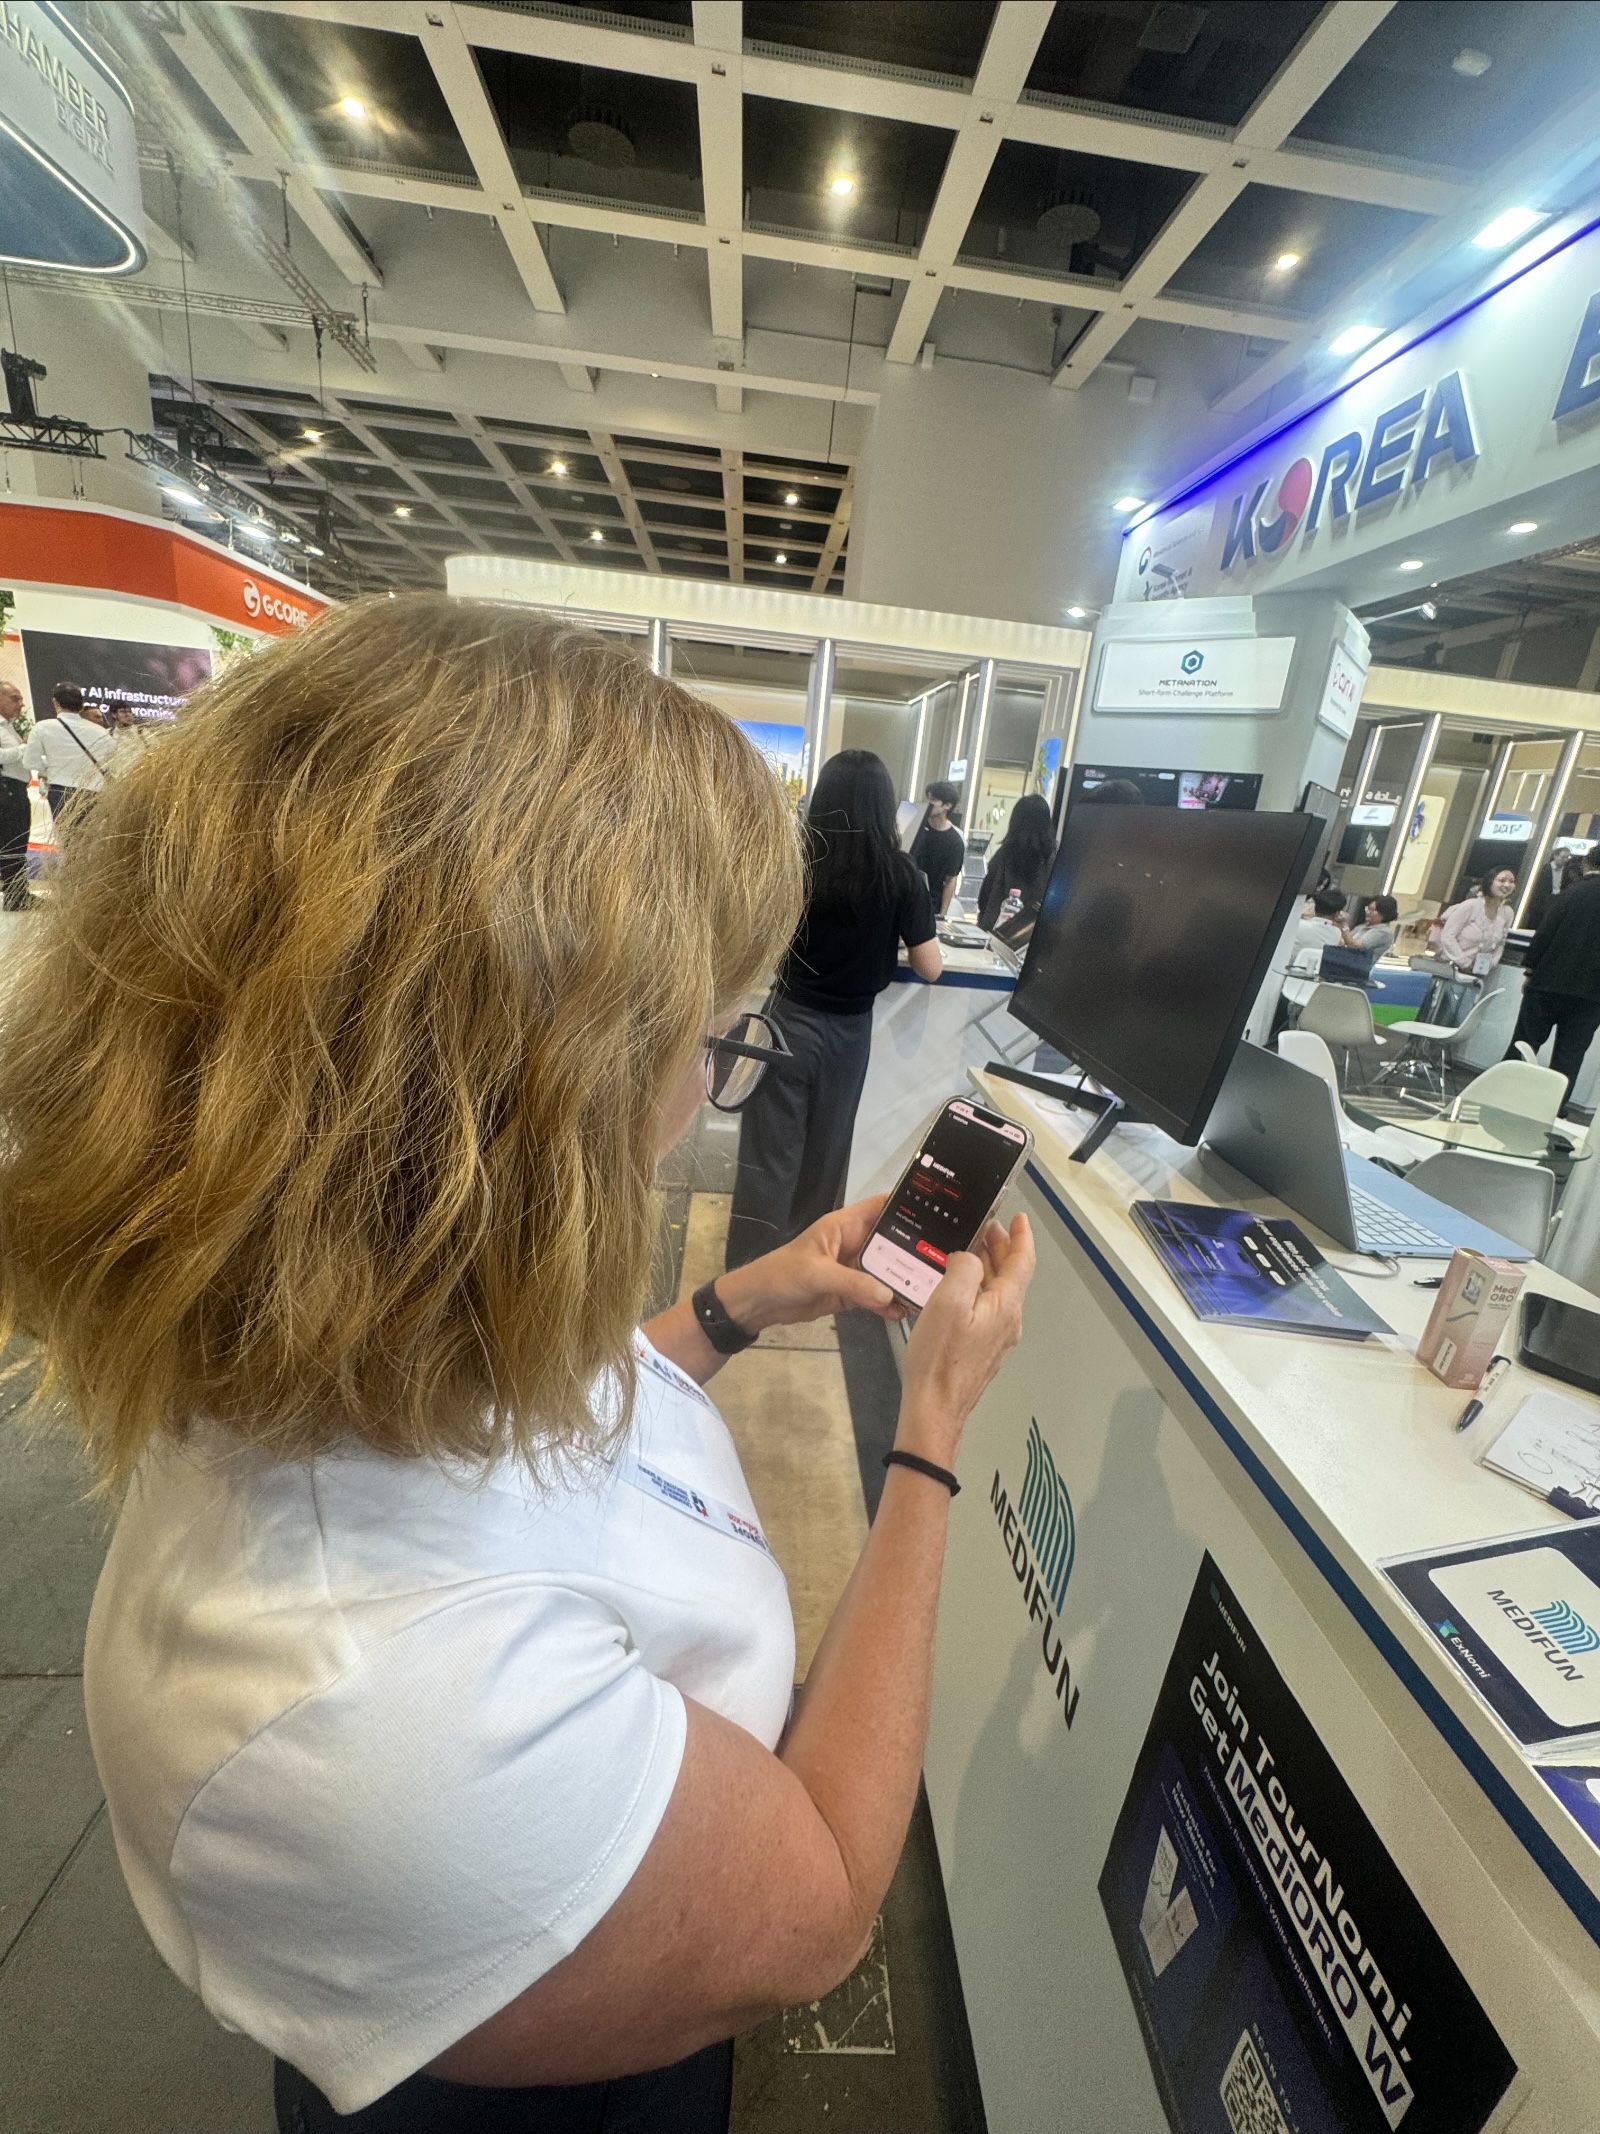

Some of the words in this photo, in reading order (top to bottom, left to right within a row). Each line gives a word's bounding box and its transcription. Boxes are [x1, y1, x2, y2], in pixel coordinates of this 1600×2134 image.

[0, 0, 110, 142] HAMBER
[1220, 369, 1480, 571] KOREA
[262, 594, 309, 627] GCORE
[89, 687, 102, 698] AI
[1159, 679, 1218, 687] METANATION
[1173, 689, 1203, 698] Challenge
[1490, 1294, 1514, 1302] ORO
[1493, 1284, 1518, 1295] Medi
[990, 1469, 1080, 1731] MEDIFUN
[1217, 1599, 1247, 1654] MEDIFUN
[1487, 1589, 1584, 1682] MEDIFUN
[1202, 1650, 1250, 1743] Join
[1450, 1636, 1492, 1679] ExNomi
[1171, 1786, 1186, 1818] New
[1184, 1817, 1215, 1888] Members
[1175, 1778, 1205, 1850] Exclusive
[1205, 1847, 1217, 1872] for
[1189, 1674, 1230, 1766] Get
[1230, 1758, 1357, 2019] MediORO
[1364, 2022, 1406, 2105] W
[1269, 1903, 1288, 1946] While
[1287, 1945, 1317, 2010] supplies
[1252, 2022, 1277, 2079] SCAN
[1280, 2084, 1292, 2114] TO
